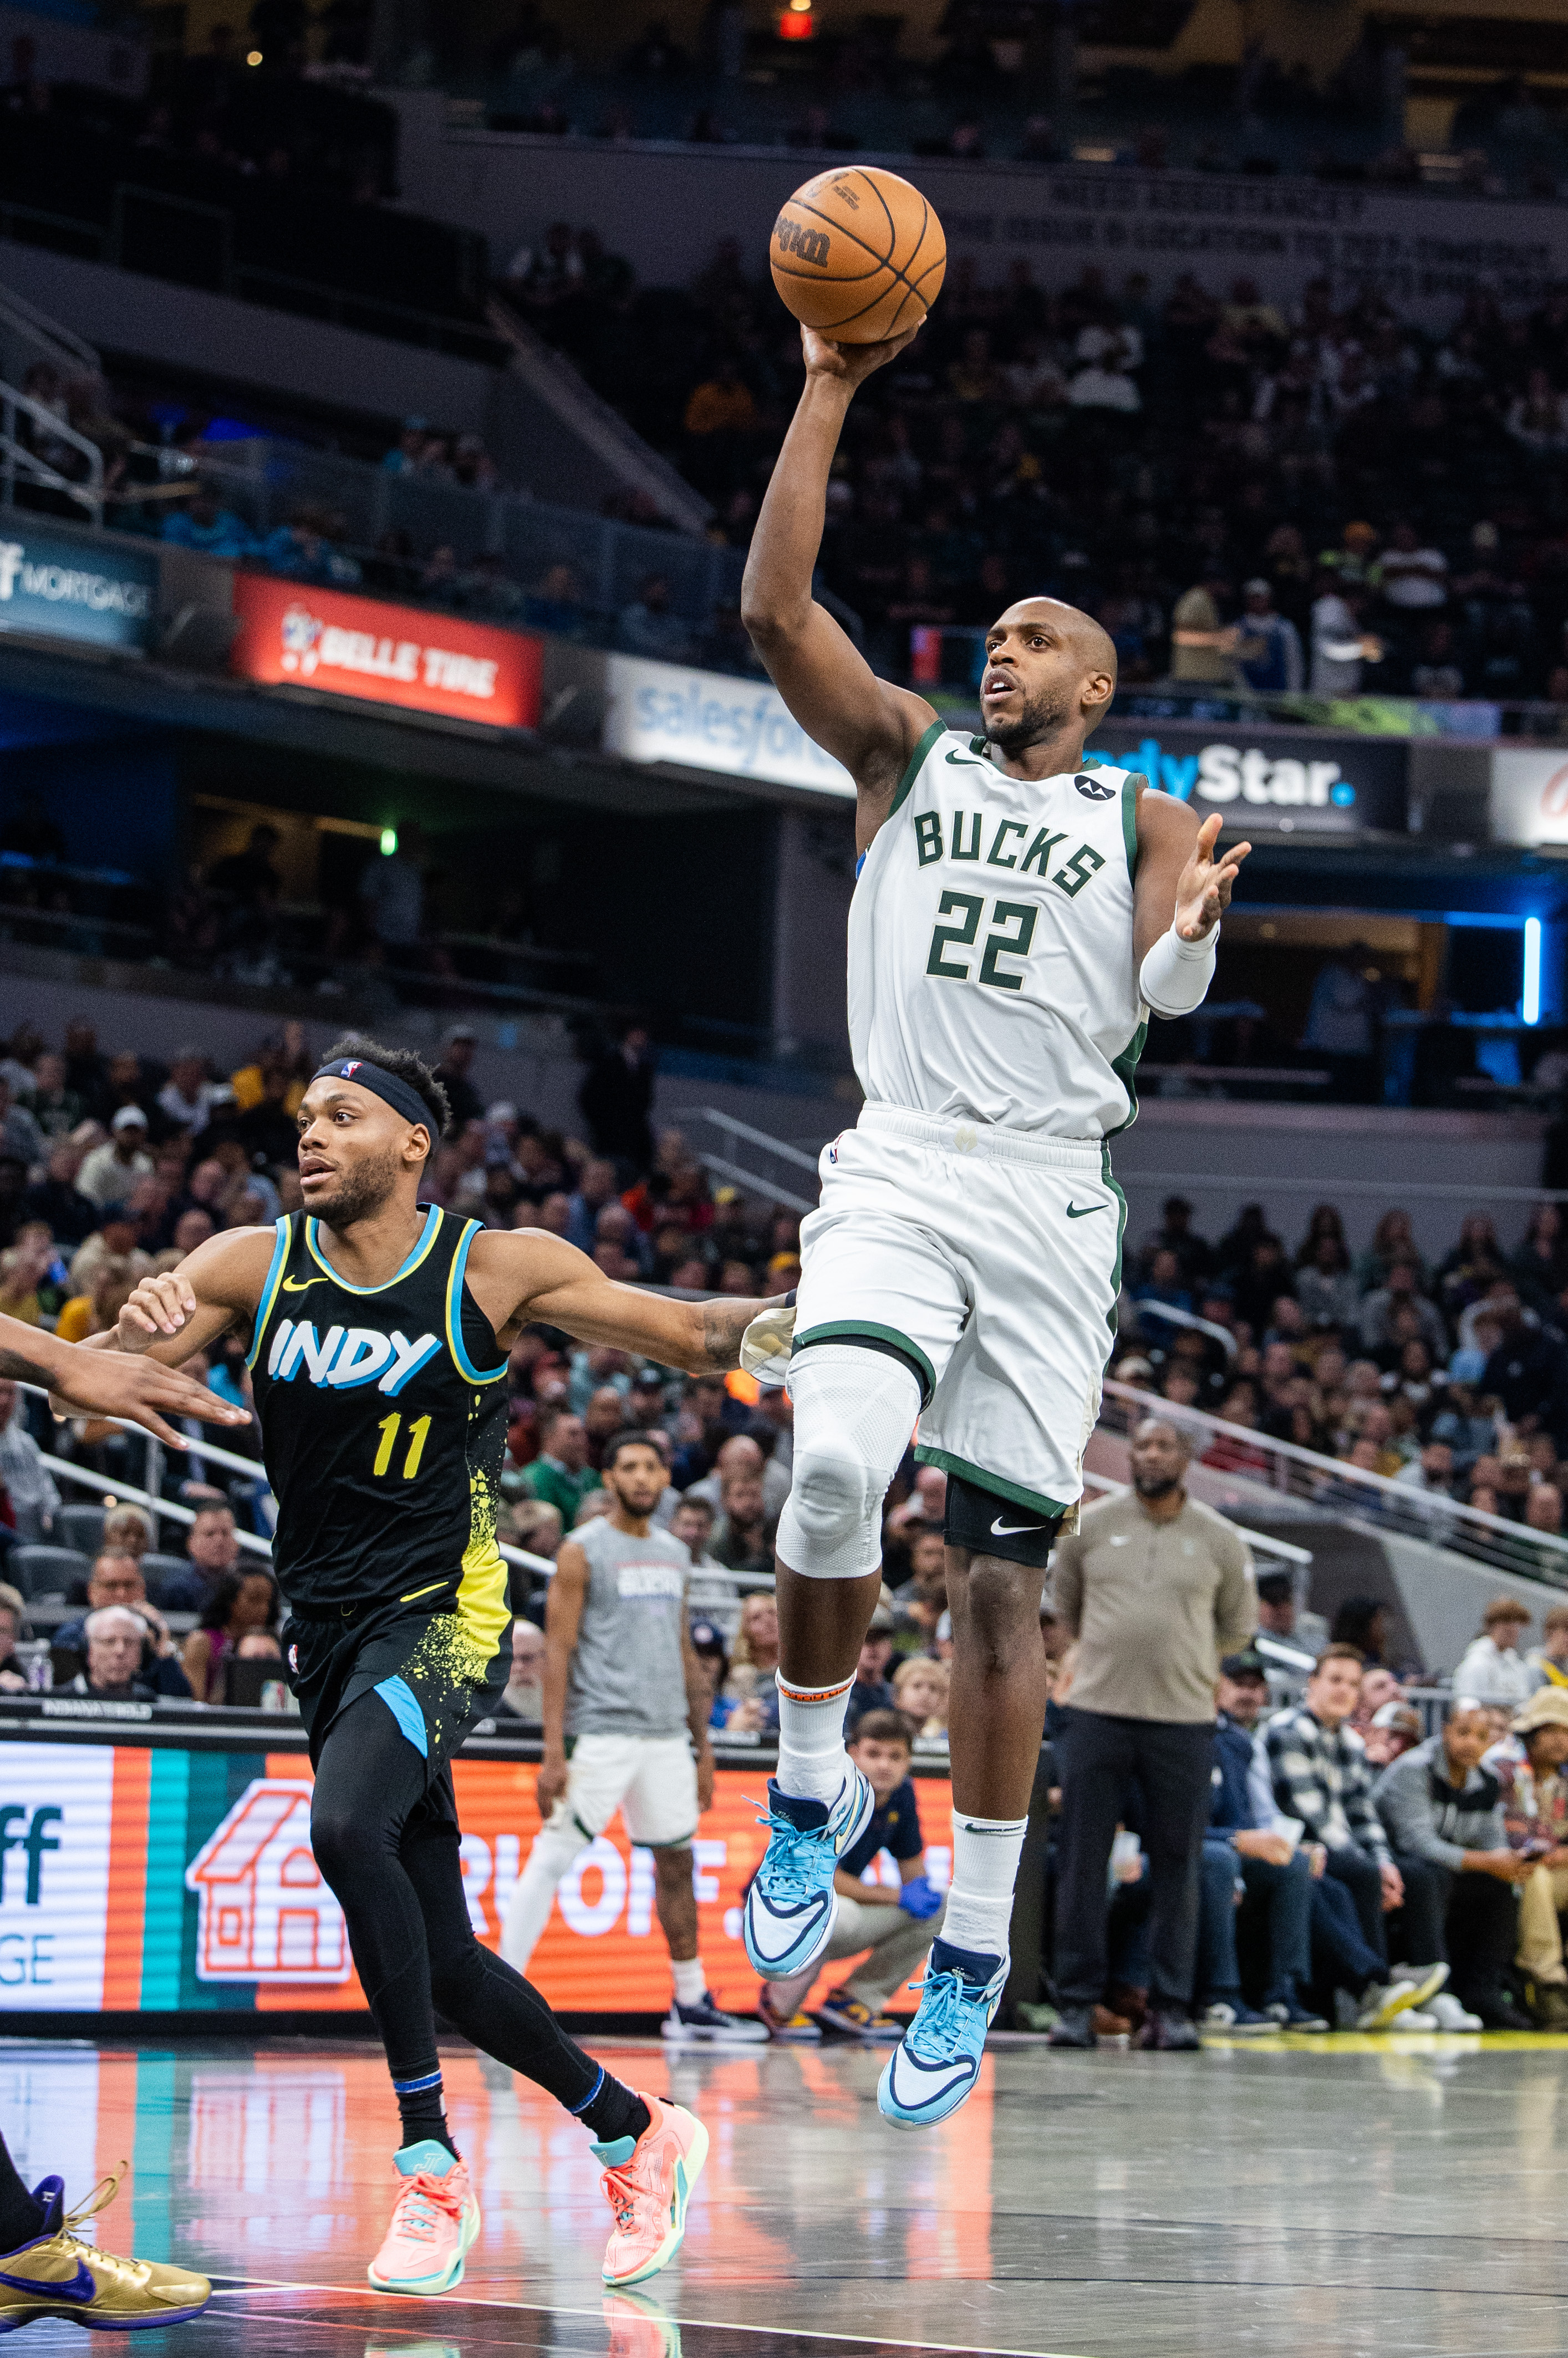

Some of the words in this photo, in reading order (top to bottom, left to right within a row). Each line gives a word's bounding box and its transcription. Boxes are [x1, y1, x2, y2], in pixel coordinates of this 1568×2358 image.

[319, 626, 421, 683] BELLE
[1082, 738, 1356, 807] dyStar.
[913, 810, 1106, 901] BUCKS
[923, 887, 1041, 993] 22
[268, 1318, 443, 1397] INDY
[373, 1411, 432, 1480] 11
